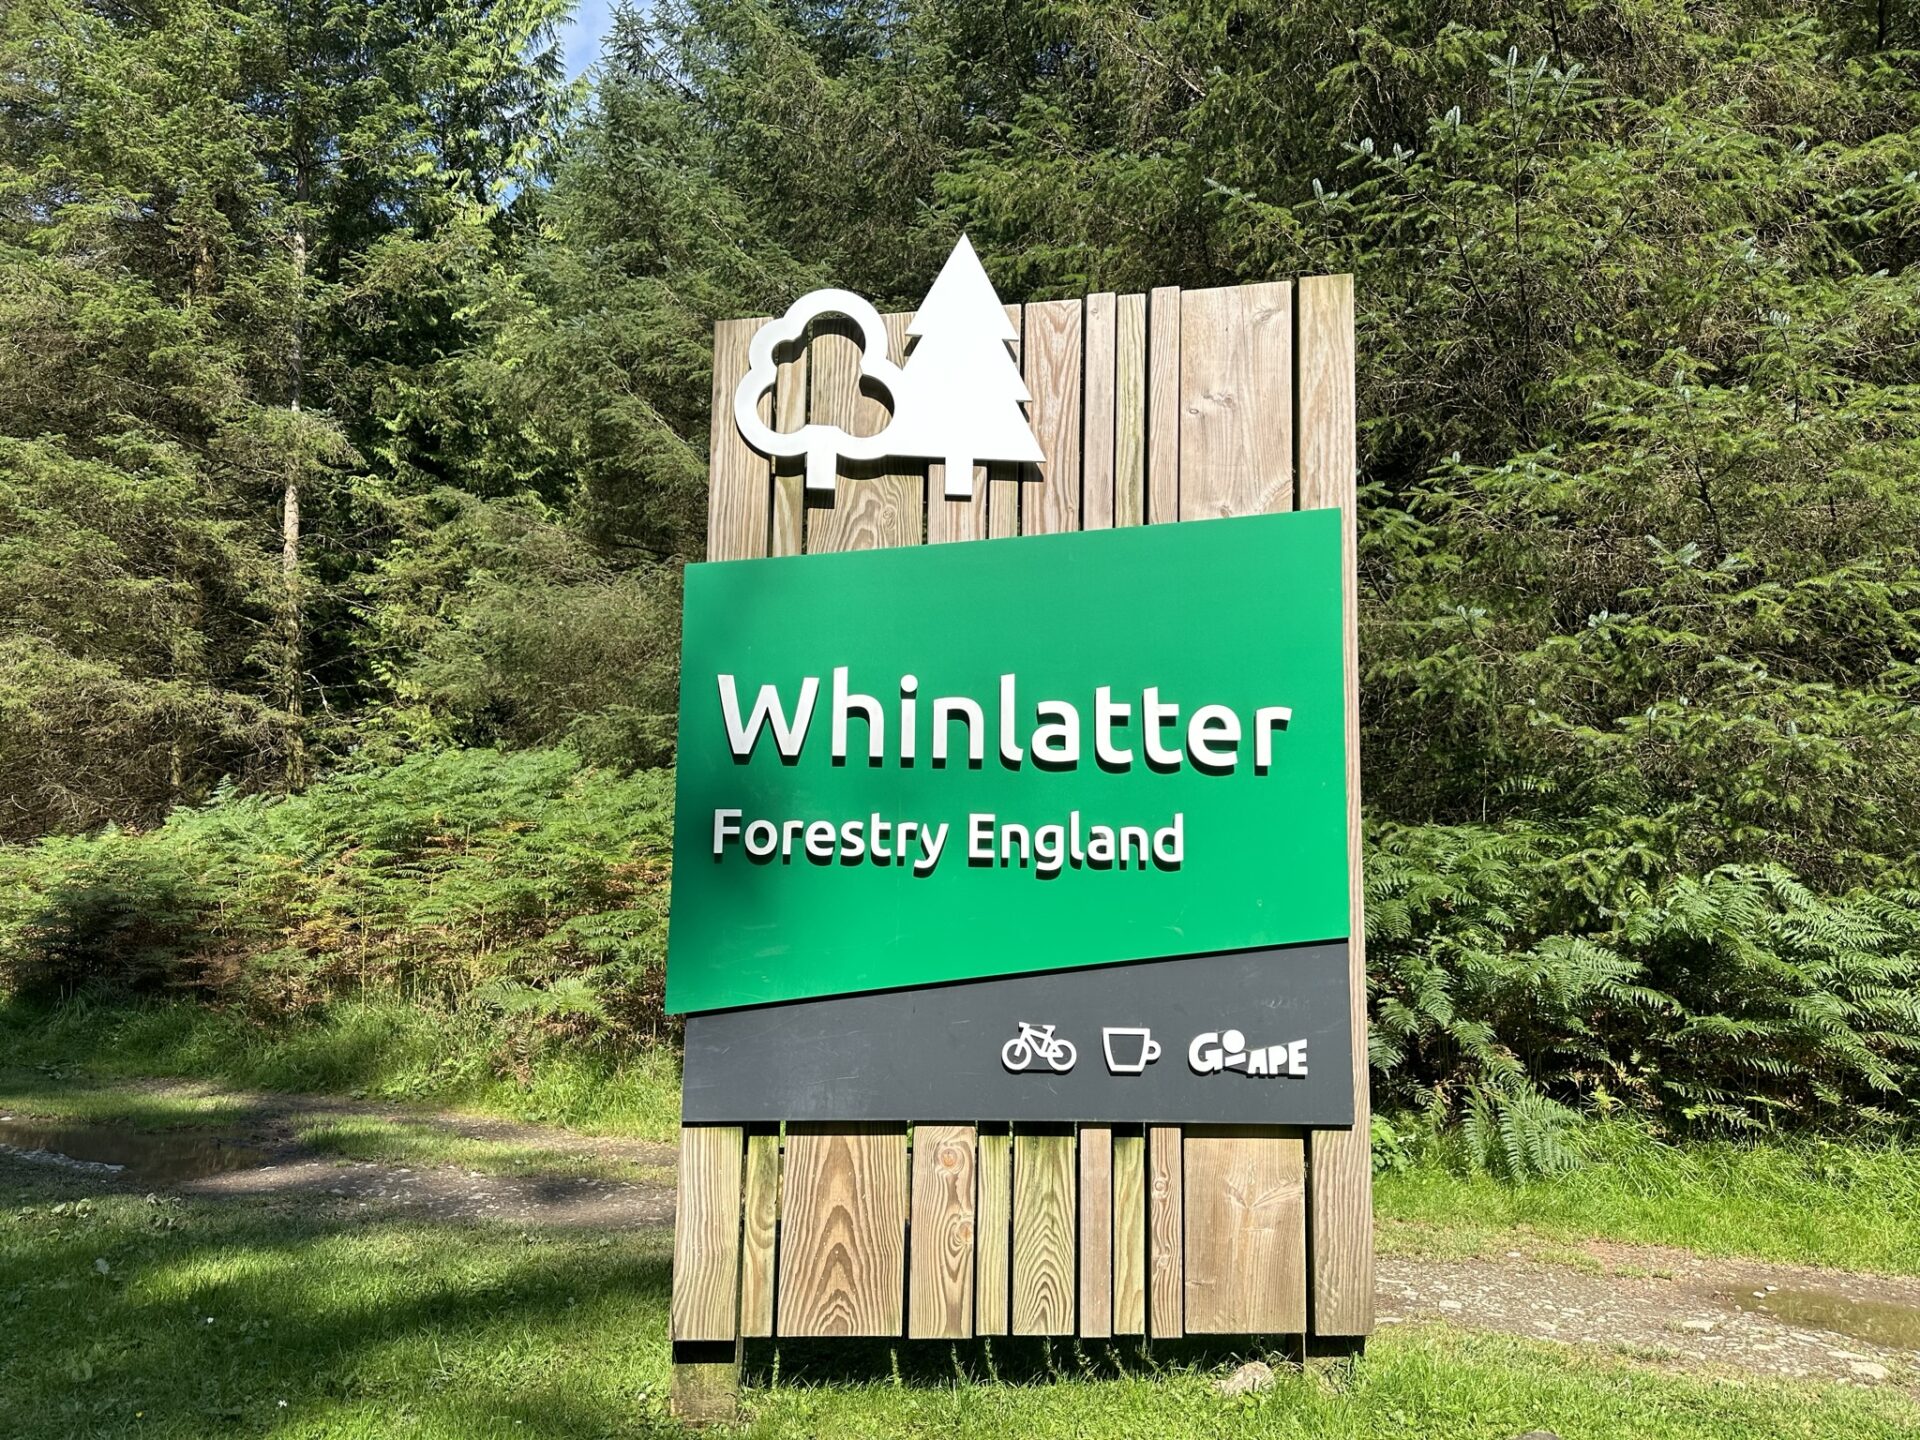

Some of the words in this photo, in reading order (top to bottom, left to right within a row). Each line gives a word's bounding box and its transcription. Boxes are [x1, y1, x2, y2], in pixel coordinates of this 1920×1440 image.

[718, 667, 1291, 766] Whinlatter
[714, 809, 948, 868] Forestry
[969, 811, 1183, 870] England
